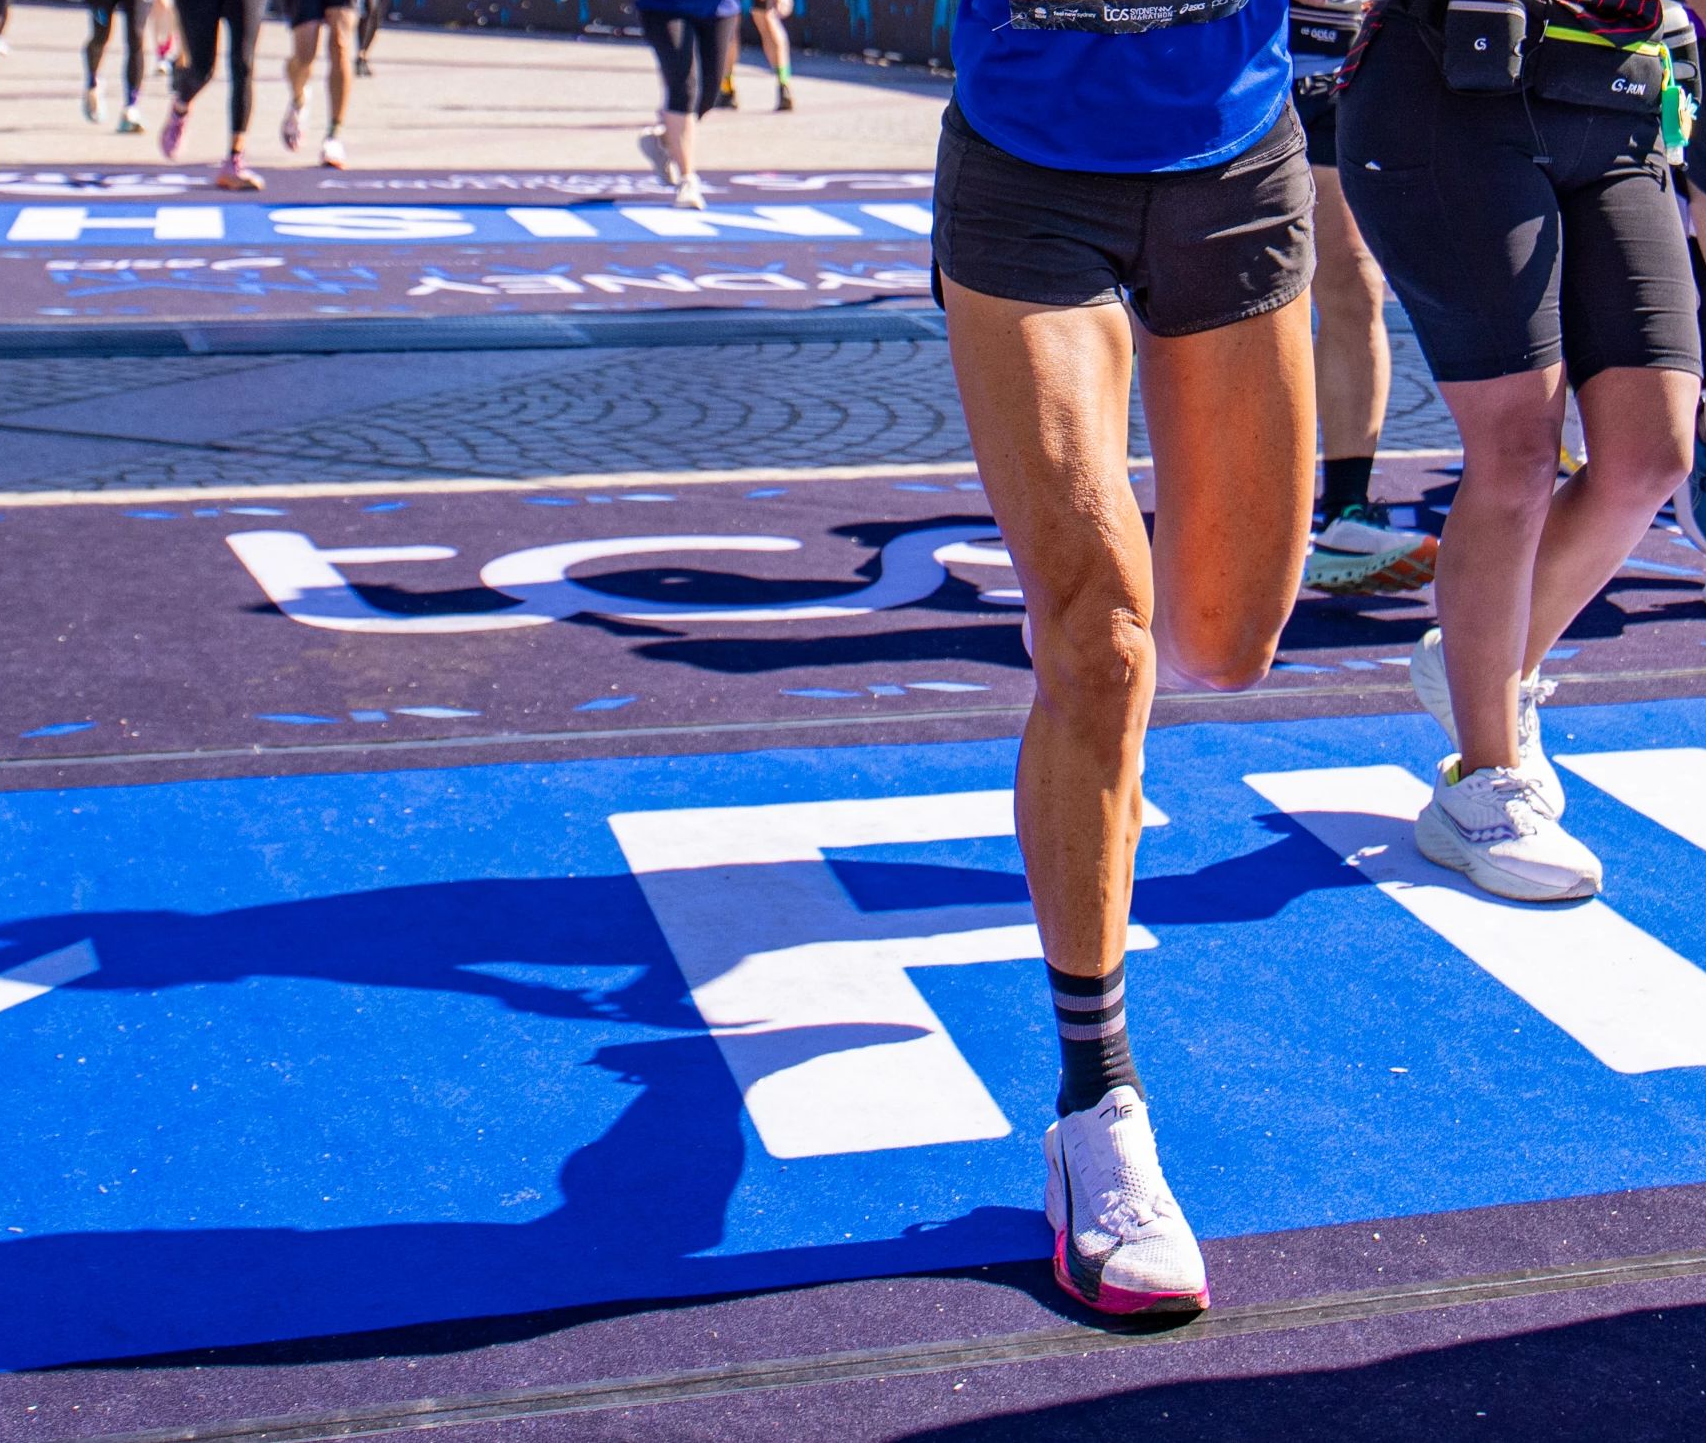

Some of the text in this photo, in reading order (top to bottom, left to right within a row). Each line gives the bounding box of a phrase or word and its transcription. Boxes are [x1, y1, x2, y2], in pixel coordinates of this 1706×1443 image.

[1103, 5, 1130, 22] tcs
[6, 204, 934, 242] INISH
[406, 269, 933, 296] SYDNEY
